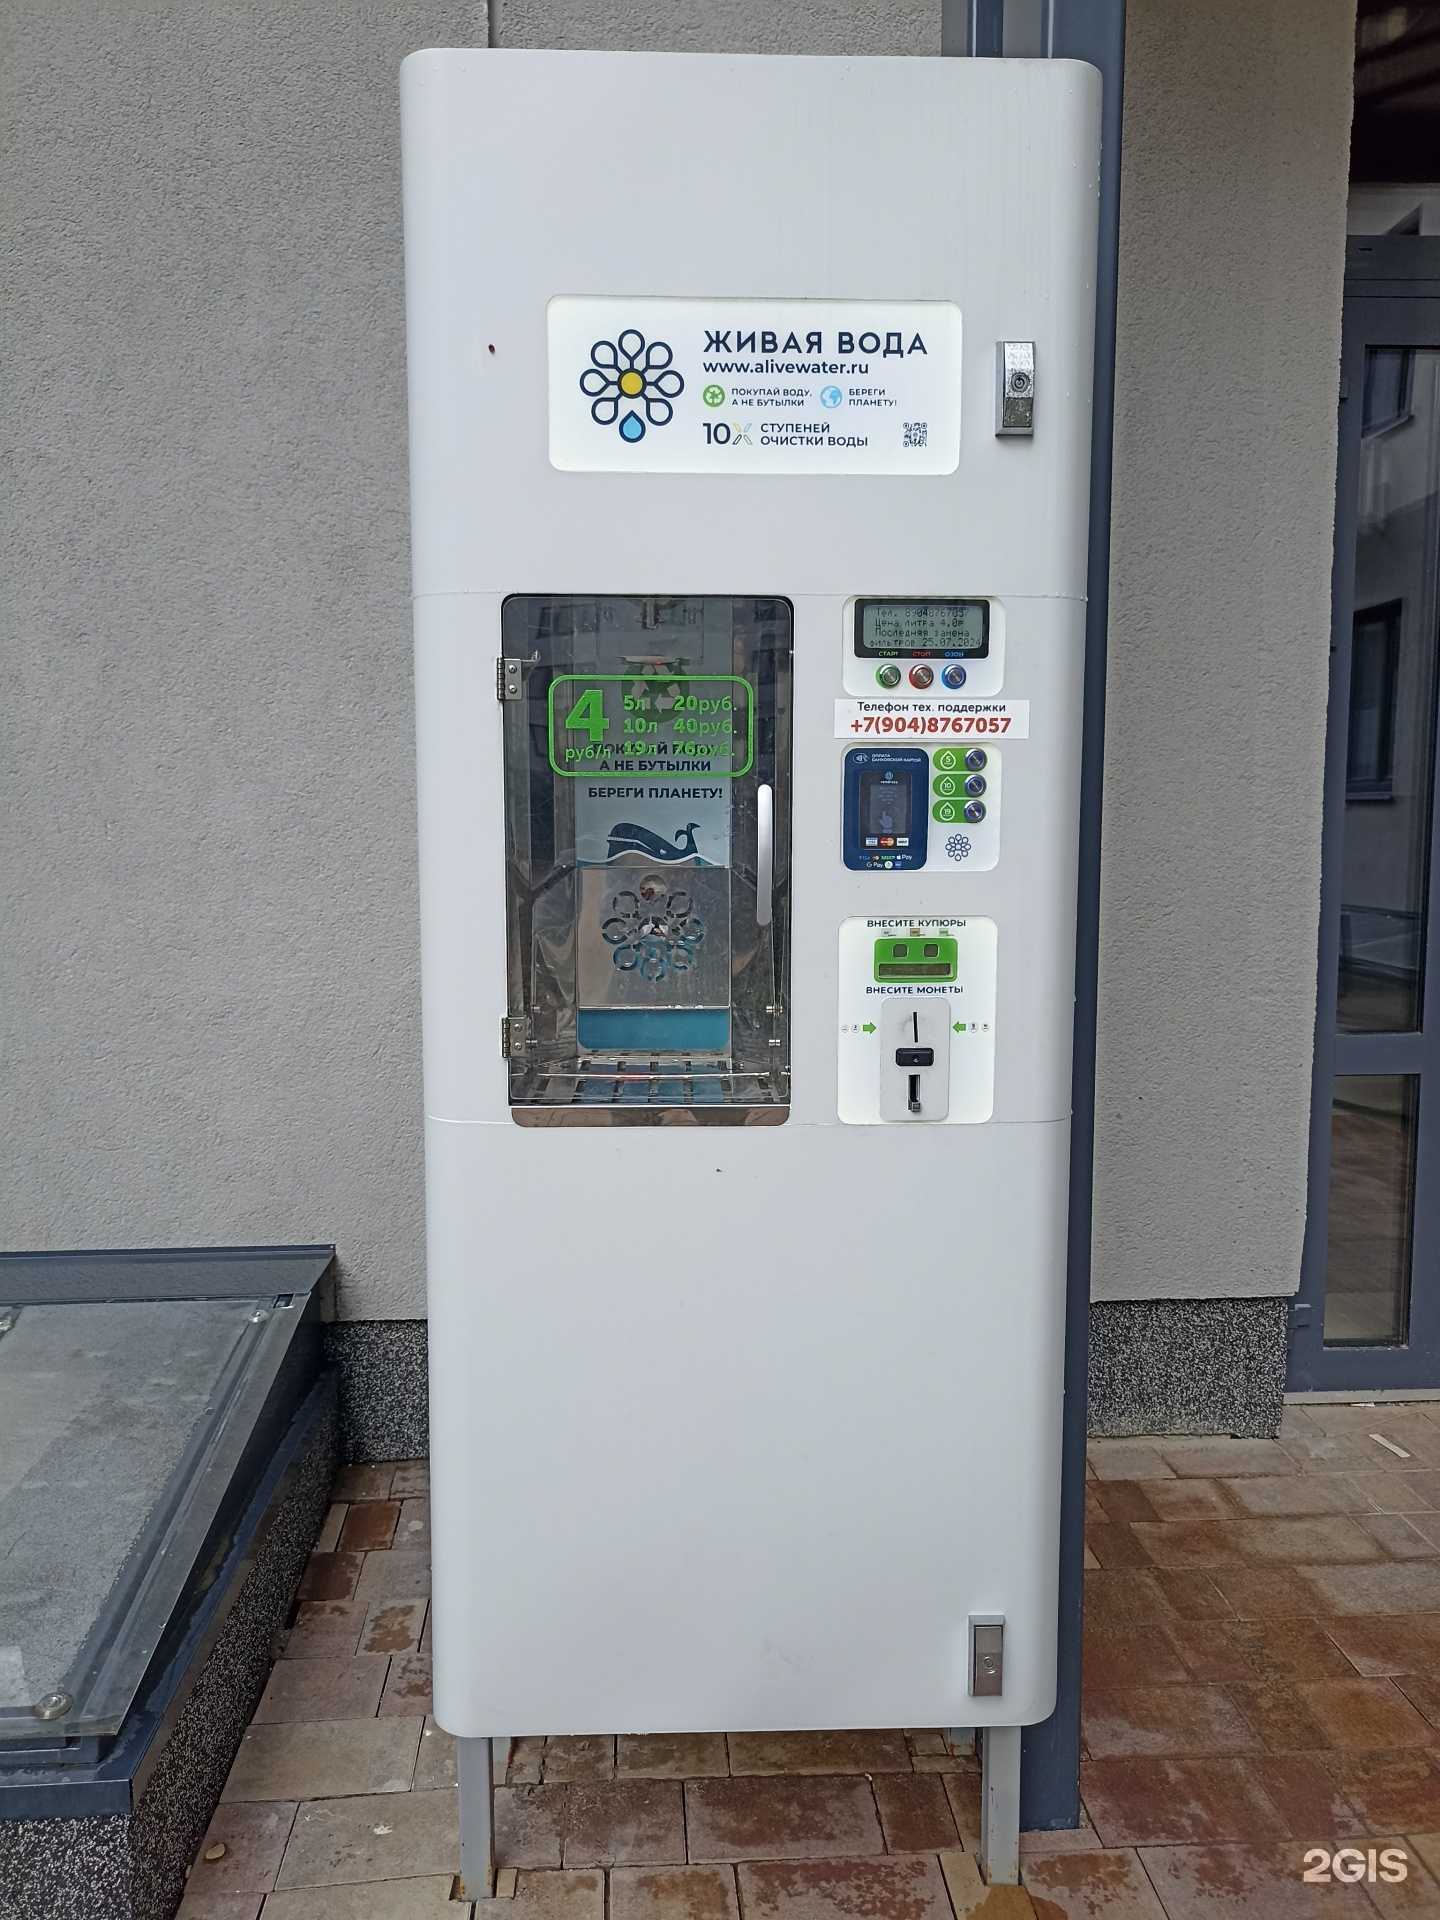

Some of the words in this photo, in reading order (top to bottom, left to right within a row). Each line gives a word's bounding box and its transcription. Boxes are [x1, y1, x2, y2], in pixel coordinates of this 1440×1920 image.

[703, 330, 822, 354] ЖИВАЯ
[838, 331, 928, 358] ВОДА
[703, 359, 869, 374] www.alivewater.ru
[731, 387, 780, 397] ПОКУПАЙ
[849, 388, 886, 397] БЕРЕГИ
[731, 399, 738, 407] А
[741, 399, 754, 407] НЕ
[756, 399, 804, 407] БУТЫЛКИ
[849, 399, 897, 407] ПЛАНЕТУ!
[760, 421, 830, 433] СТУПЕНЕЙ
[760, 436, 824, 447] ОЧИСТКИ
[827, 437, 868, 448] ВОДЫ
[623, 695, 646, 711] 5л
[672, 695, 738, 715] 20руб.
[857, 701, 909, 714] Телефон
[913, 703, 935, 712] тех.
[938, 703, 1006, 714] поддержки
[565, 689, 610, 742] 4
[623, 718, 658, 734] 10л
[672, 718, 738, 738] 40руб.
[850, 716, 1012, 735] +7(904)8767057
[565, 744, 611, 762] руб/л
[599, 760, 610, 772] А
[614, 760, 634, 772] НЕ
[638, 760, 711, 772] БУТЫЛКИ
[588, 787, 644, 799] БЕРЕГИ
[648, 787, 723, 799] ПЛАНЕТУ!
[867, 919, 914, 928] ВНЕСИТЕ
[918, 919, 966, 928] КУПЮРЫ
[866, 986, 913, 994] ВНЕСИТЕ
[917, 985, 963, 994] МОНЕТЫ
